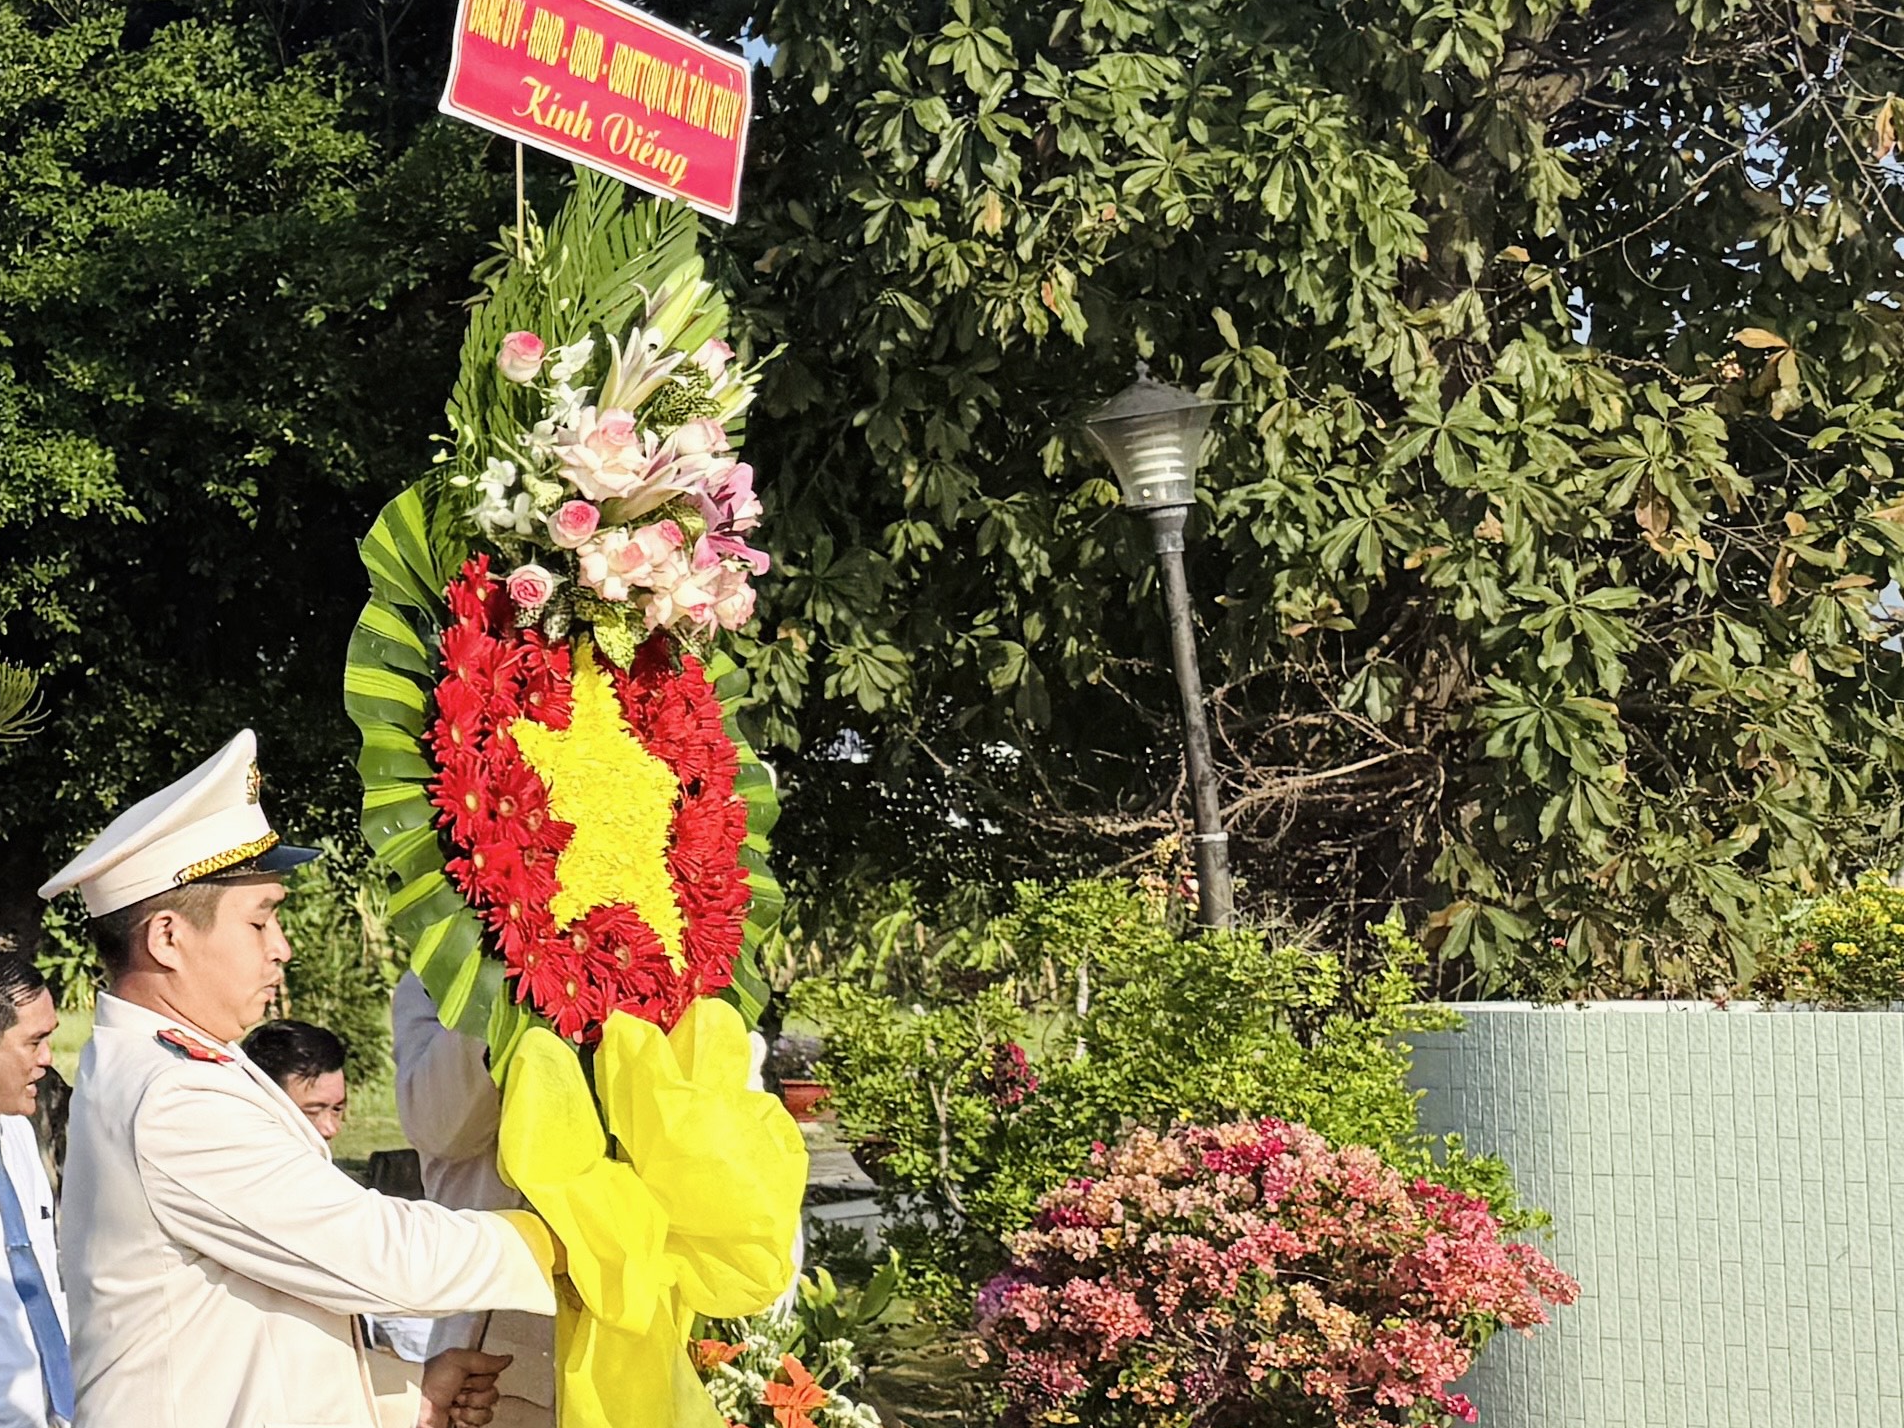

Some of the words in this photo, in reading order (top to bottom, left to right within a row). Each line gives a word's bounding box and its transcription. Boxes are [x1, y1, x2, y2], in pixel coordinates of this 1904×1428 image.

[568, 24, 604, 84] UBND
[512, 75, 593, 143] Kính
[601, 113, 689, 188] Viếng
